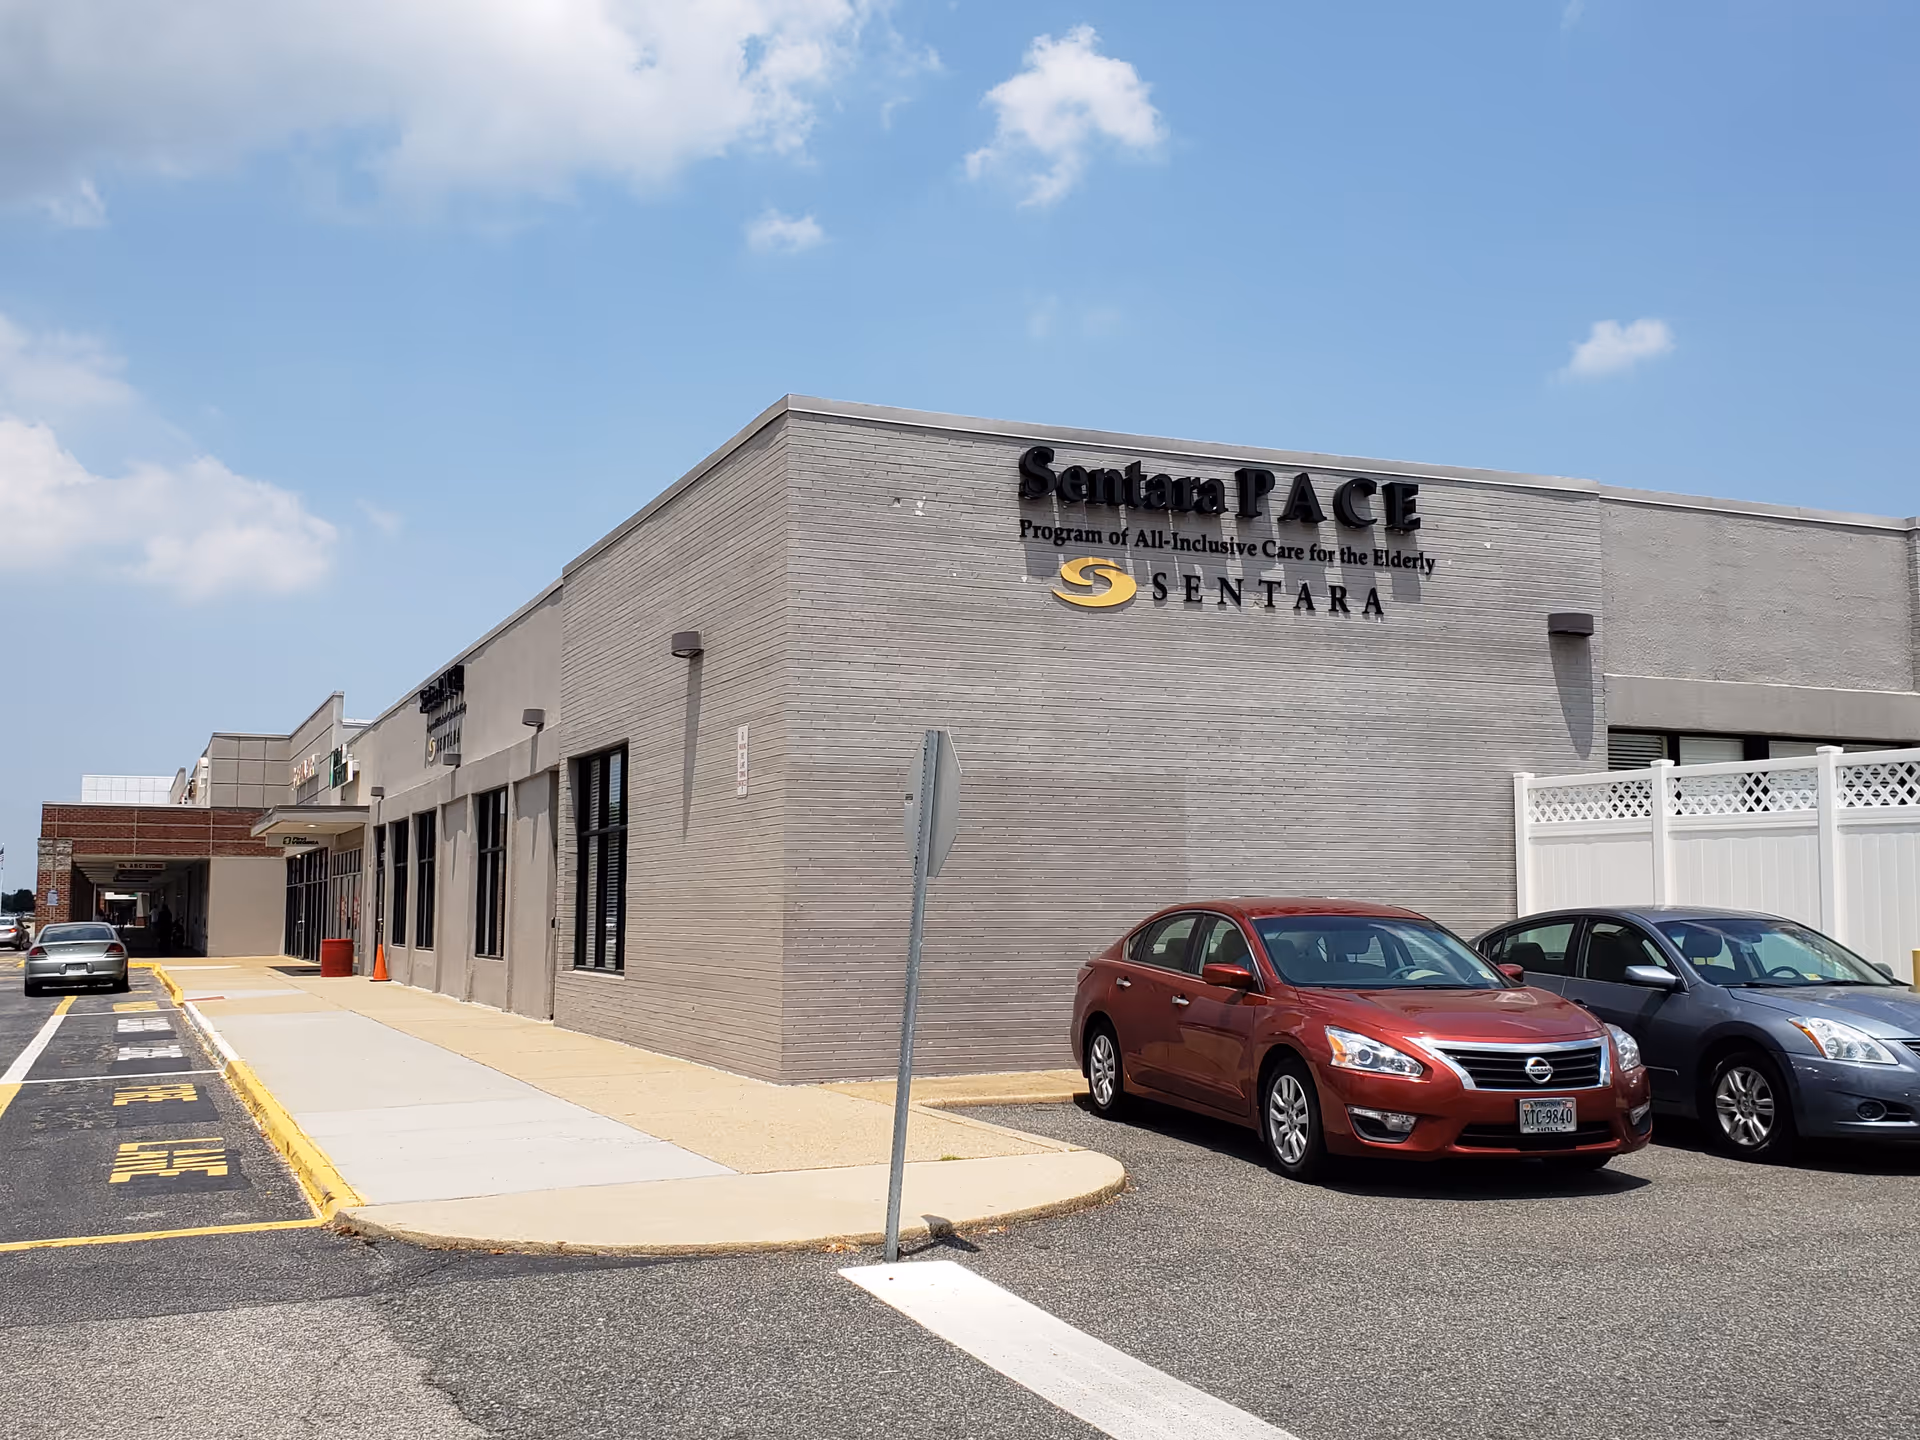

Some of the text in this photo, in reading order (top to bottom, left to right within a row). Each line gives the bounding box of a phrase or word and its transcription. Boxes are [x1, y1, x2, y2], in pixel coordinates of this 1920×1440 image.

[1019, 446, 1421, 534] Sentara PACE
[1019, 519, 1436, 575] Program of All-Inclusive Care for the Elderly
[1152, 572, 1384, 615] SENTARA
[113, 1083, 198, 1106] FIRE
[1523, 1108, 1573, 1125] XTC-9840
[109, 1138, 228, 1184] LANE
